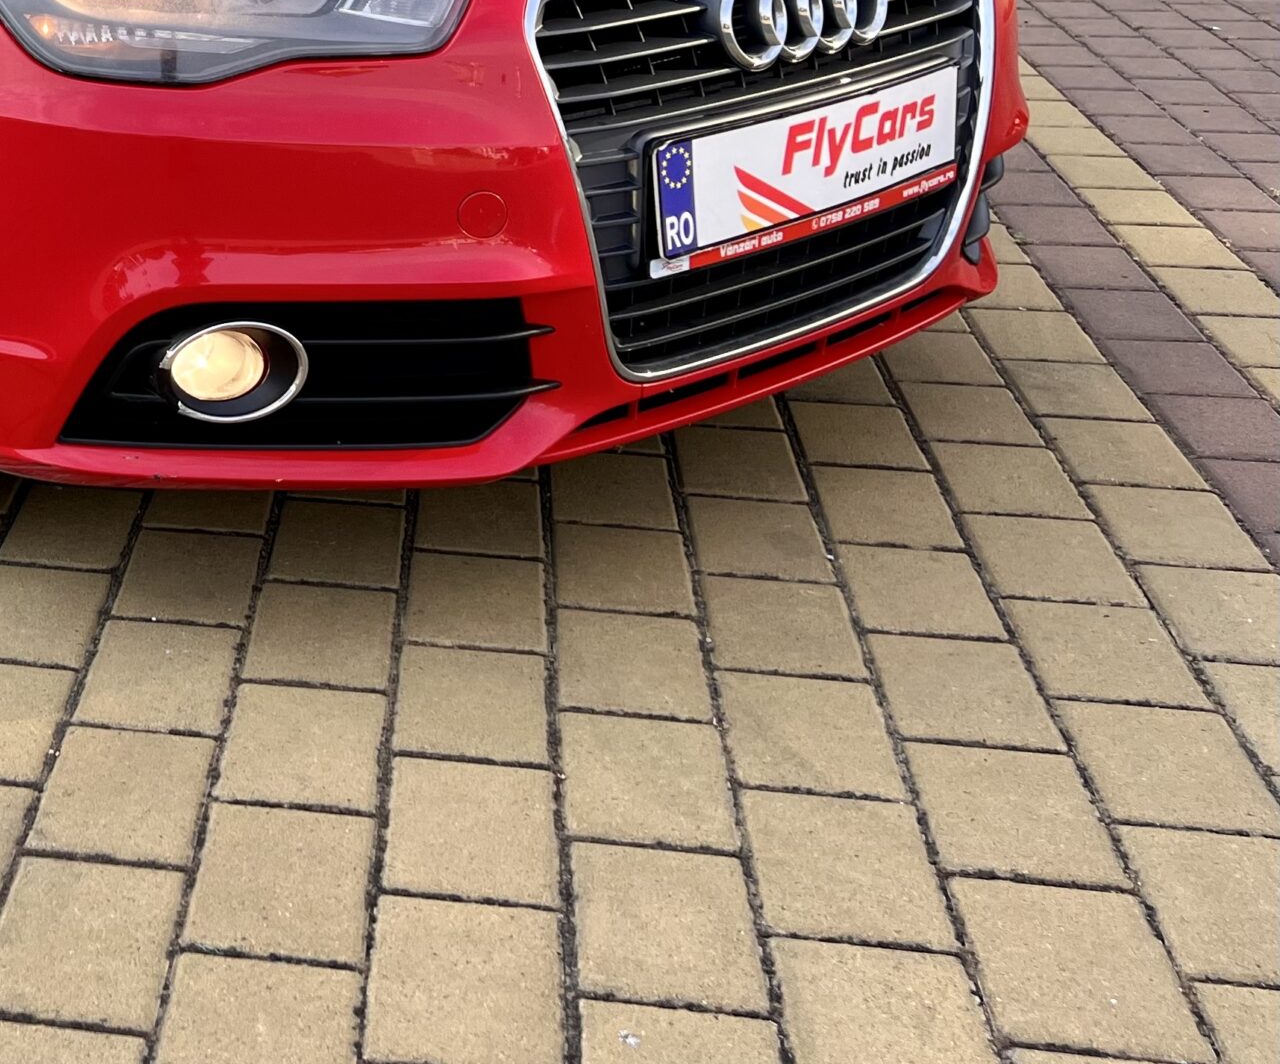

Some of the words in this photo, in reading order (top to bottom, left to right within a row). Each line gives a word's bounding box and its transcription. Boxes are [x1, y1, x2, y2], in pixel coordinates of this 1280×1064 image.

[781, 94, 936, 178] FlyCars
[843, 163, 873, 189] trust
[876, 158, 887, 177] in
[890, 143, 932, 176] passion
[665, 211, 695, 250] RO
[844, 204, 862, 219] 220
[761, 230, 784, 246] auto
